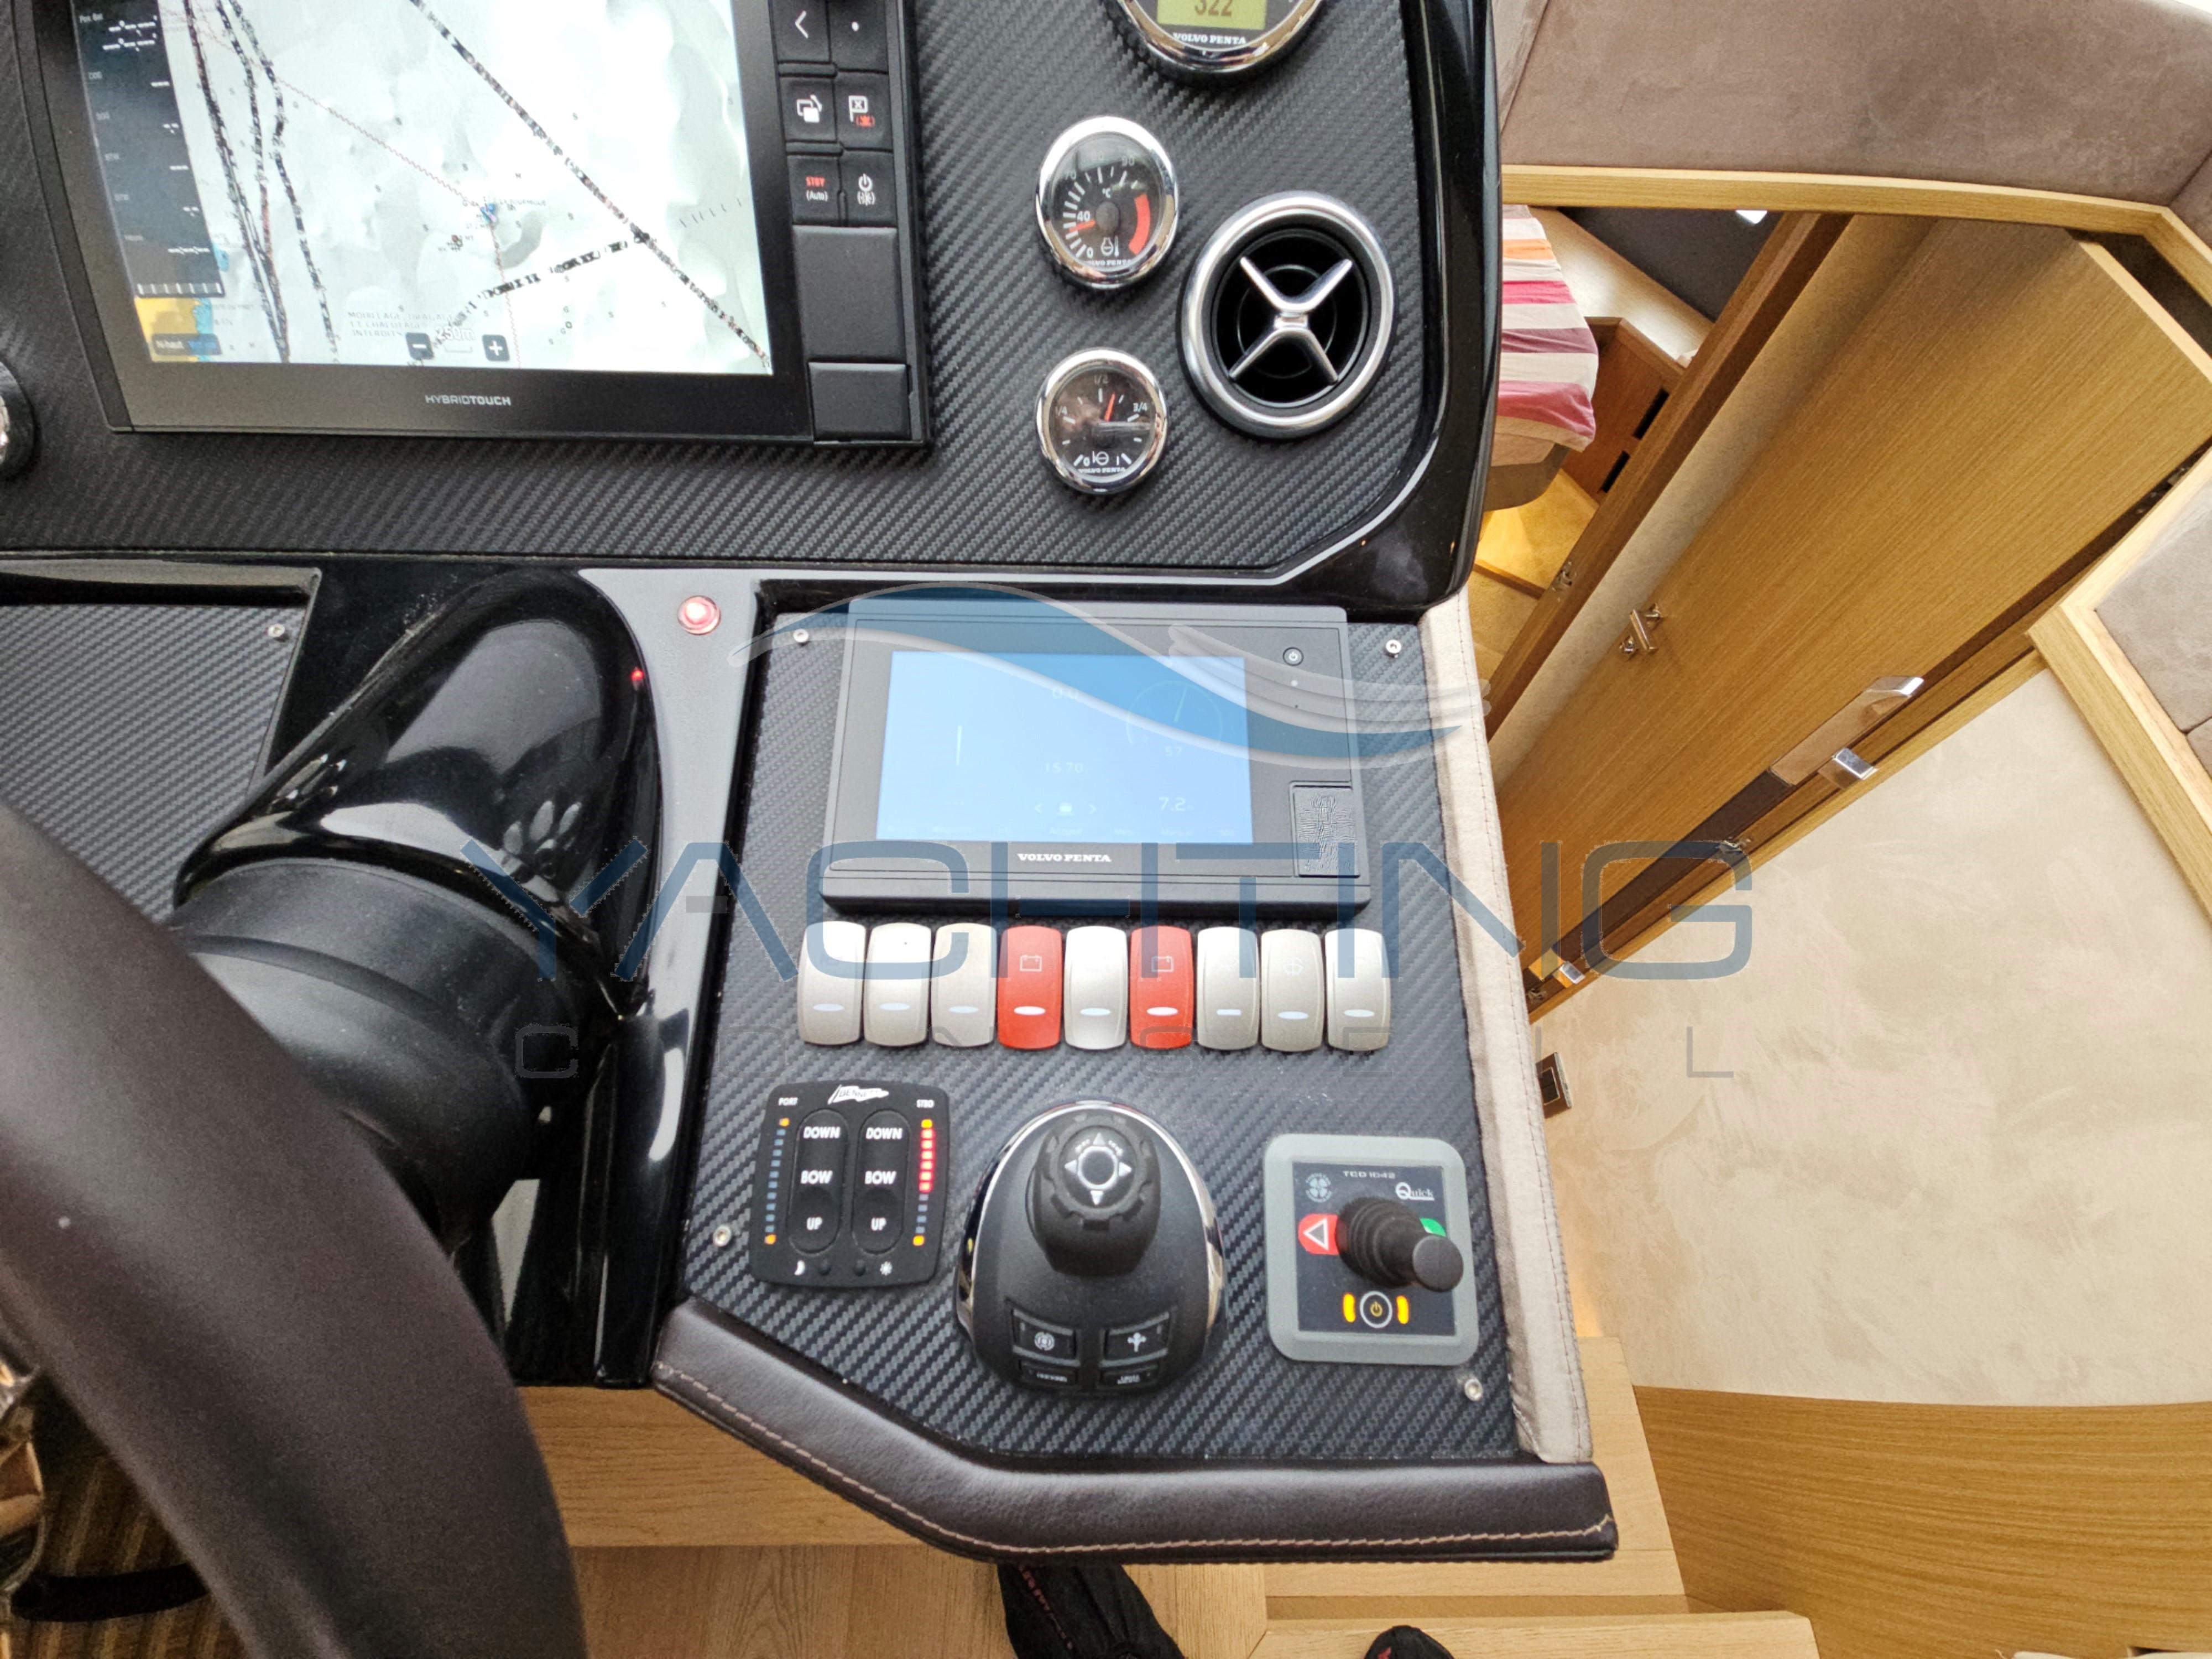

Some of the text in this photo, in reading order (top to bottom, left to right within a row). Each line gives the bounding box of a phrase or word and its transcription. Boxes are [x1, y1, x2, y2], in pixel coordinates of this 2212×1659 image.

[1172, 32, 1247, 45] VOLVO PENTA
[1077, 211, 1091, 221] 40
[1087, 248, 1094, 258] 0
[436, 326, 476, 341] 250m
[1133, 403, 1148, 413] 3/4
[1083, 457, 1091, 466] 0
[1017, 853, 1112, 862] VOLVO PENTA
[804, 1126, 841, 1139] DOWN
[865, 1127, 903, 1140] DOWN
[800, 1170, 833, 1185] BOW
[864, 1171, 896, 1185] BOW
[1395, 1182, 1435, 1201] Quick
[806, 1217, 823, 1231] UP
[871, 1217, 887, 1232] UP
